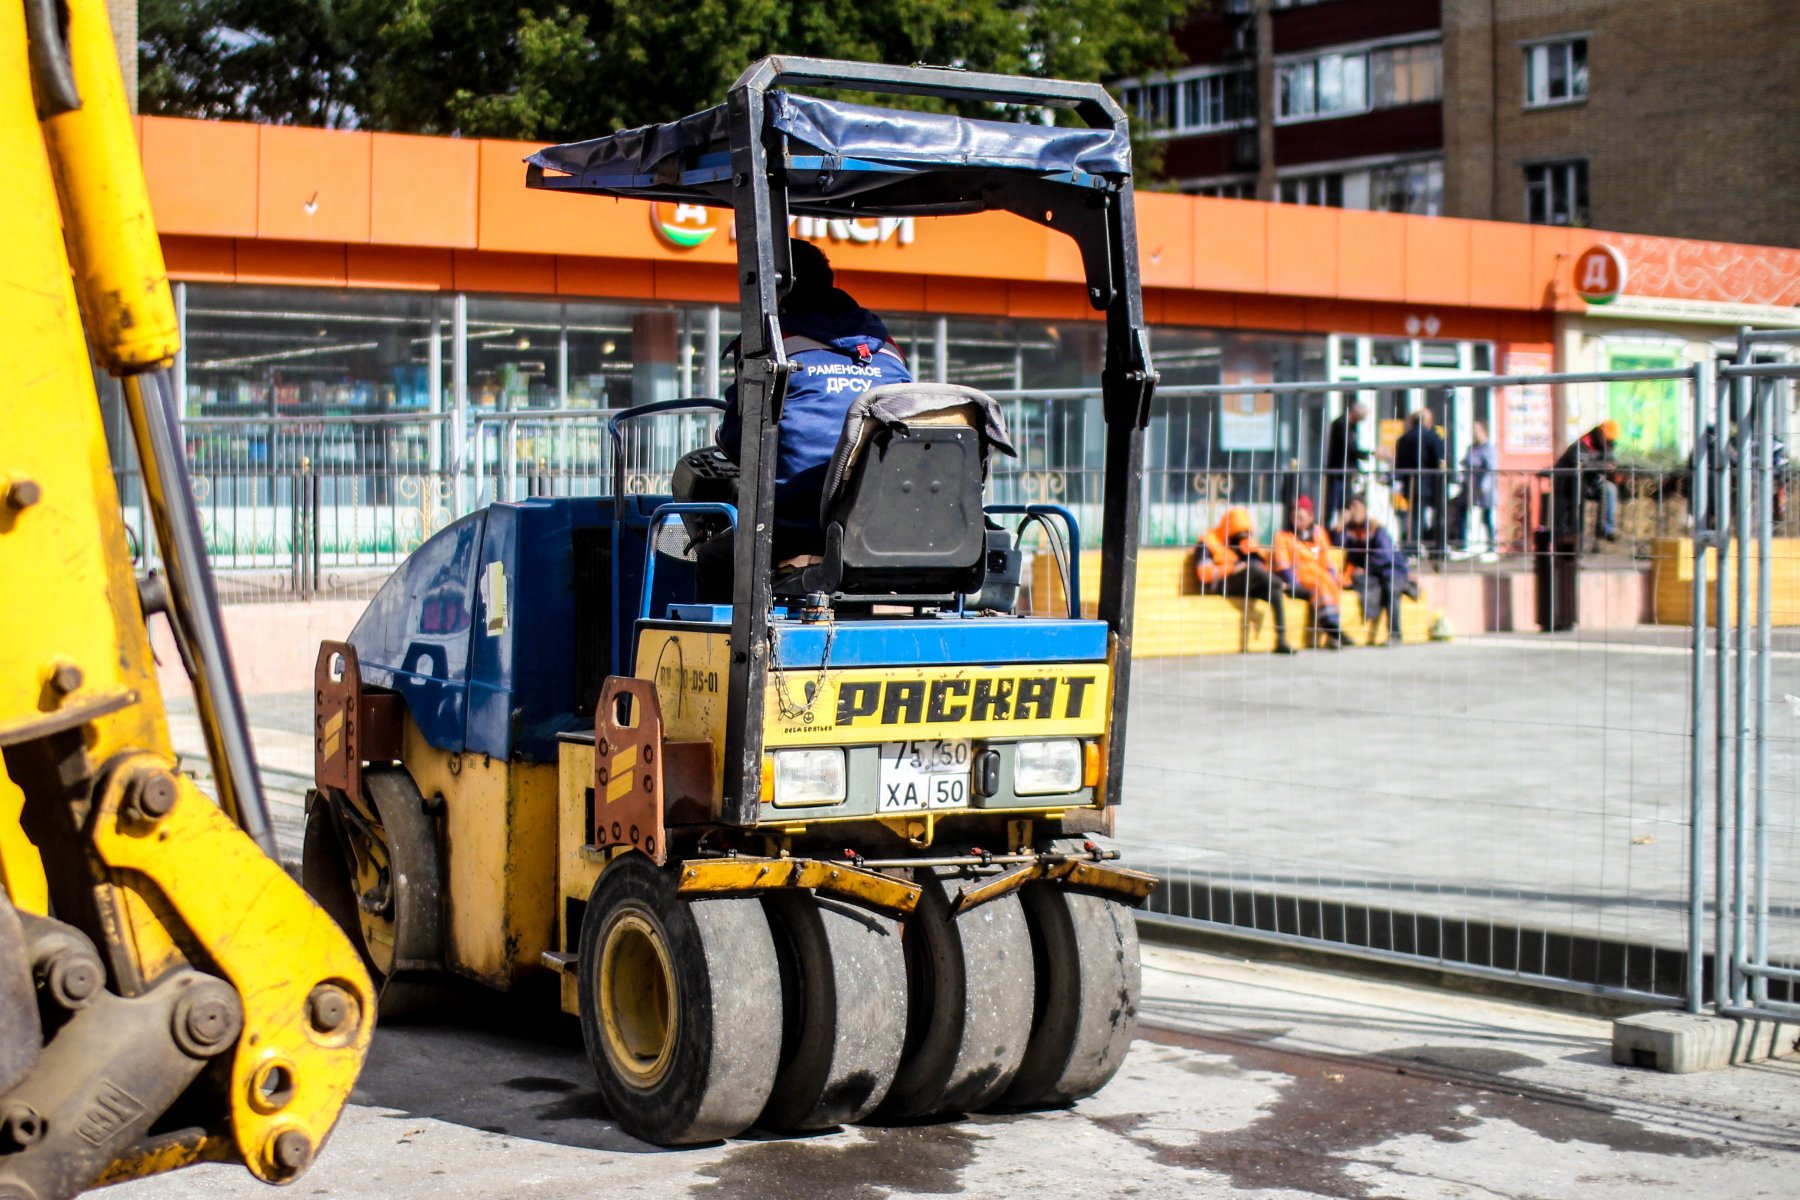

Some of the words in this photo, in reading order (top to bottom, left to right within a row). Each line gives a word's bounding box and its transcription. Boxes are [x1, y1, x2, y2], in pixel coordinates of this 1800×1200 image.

[1582, 254, 1608, 291] Д
[807, 363, 882, 377] РАМЕНСКОЕ
[826, 377, 872, 393] ДРСУ
[835, 676, 1096, 726] РАСКАТ
[886, 782, 918, 807] ХА
[936, 780, 964, 804] 50
